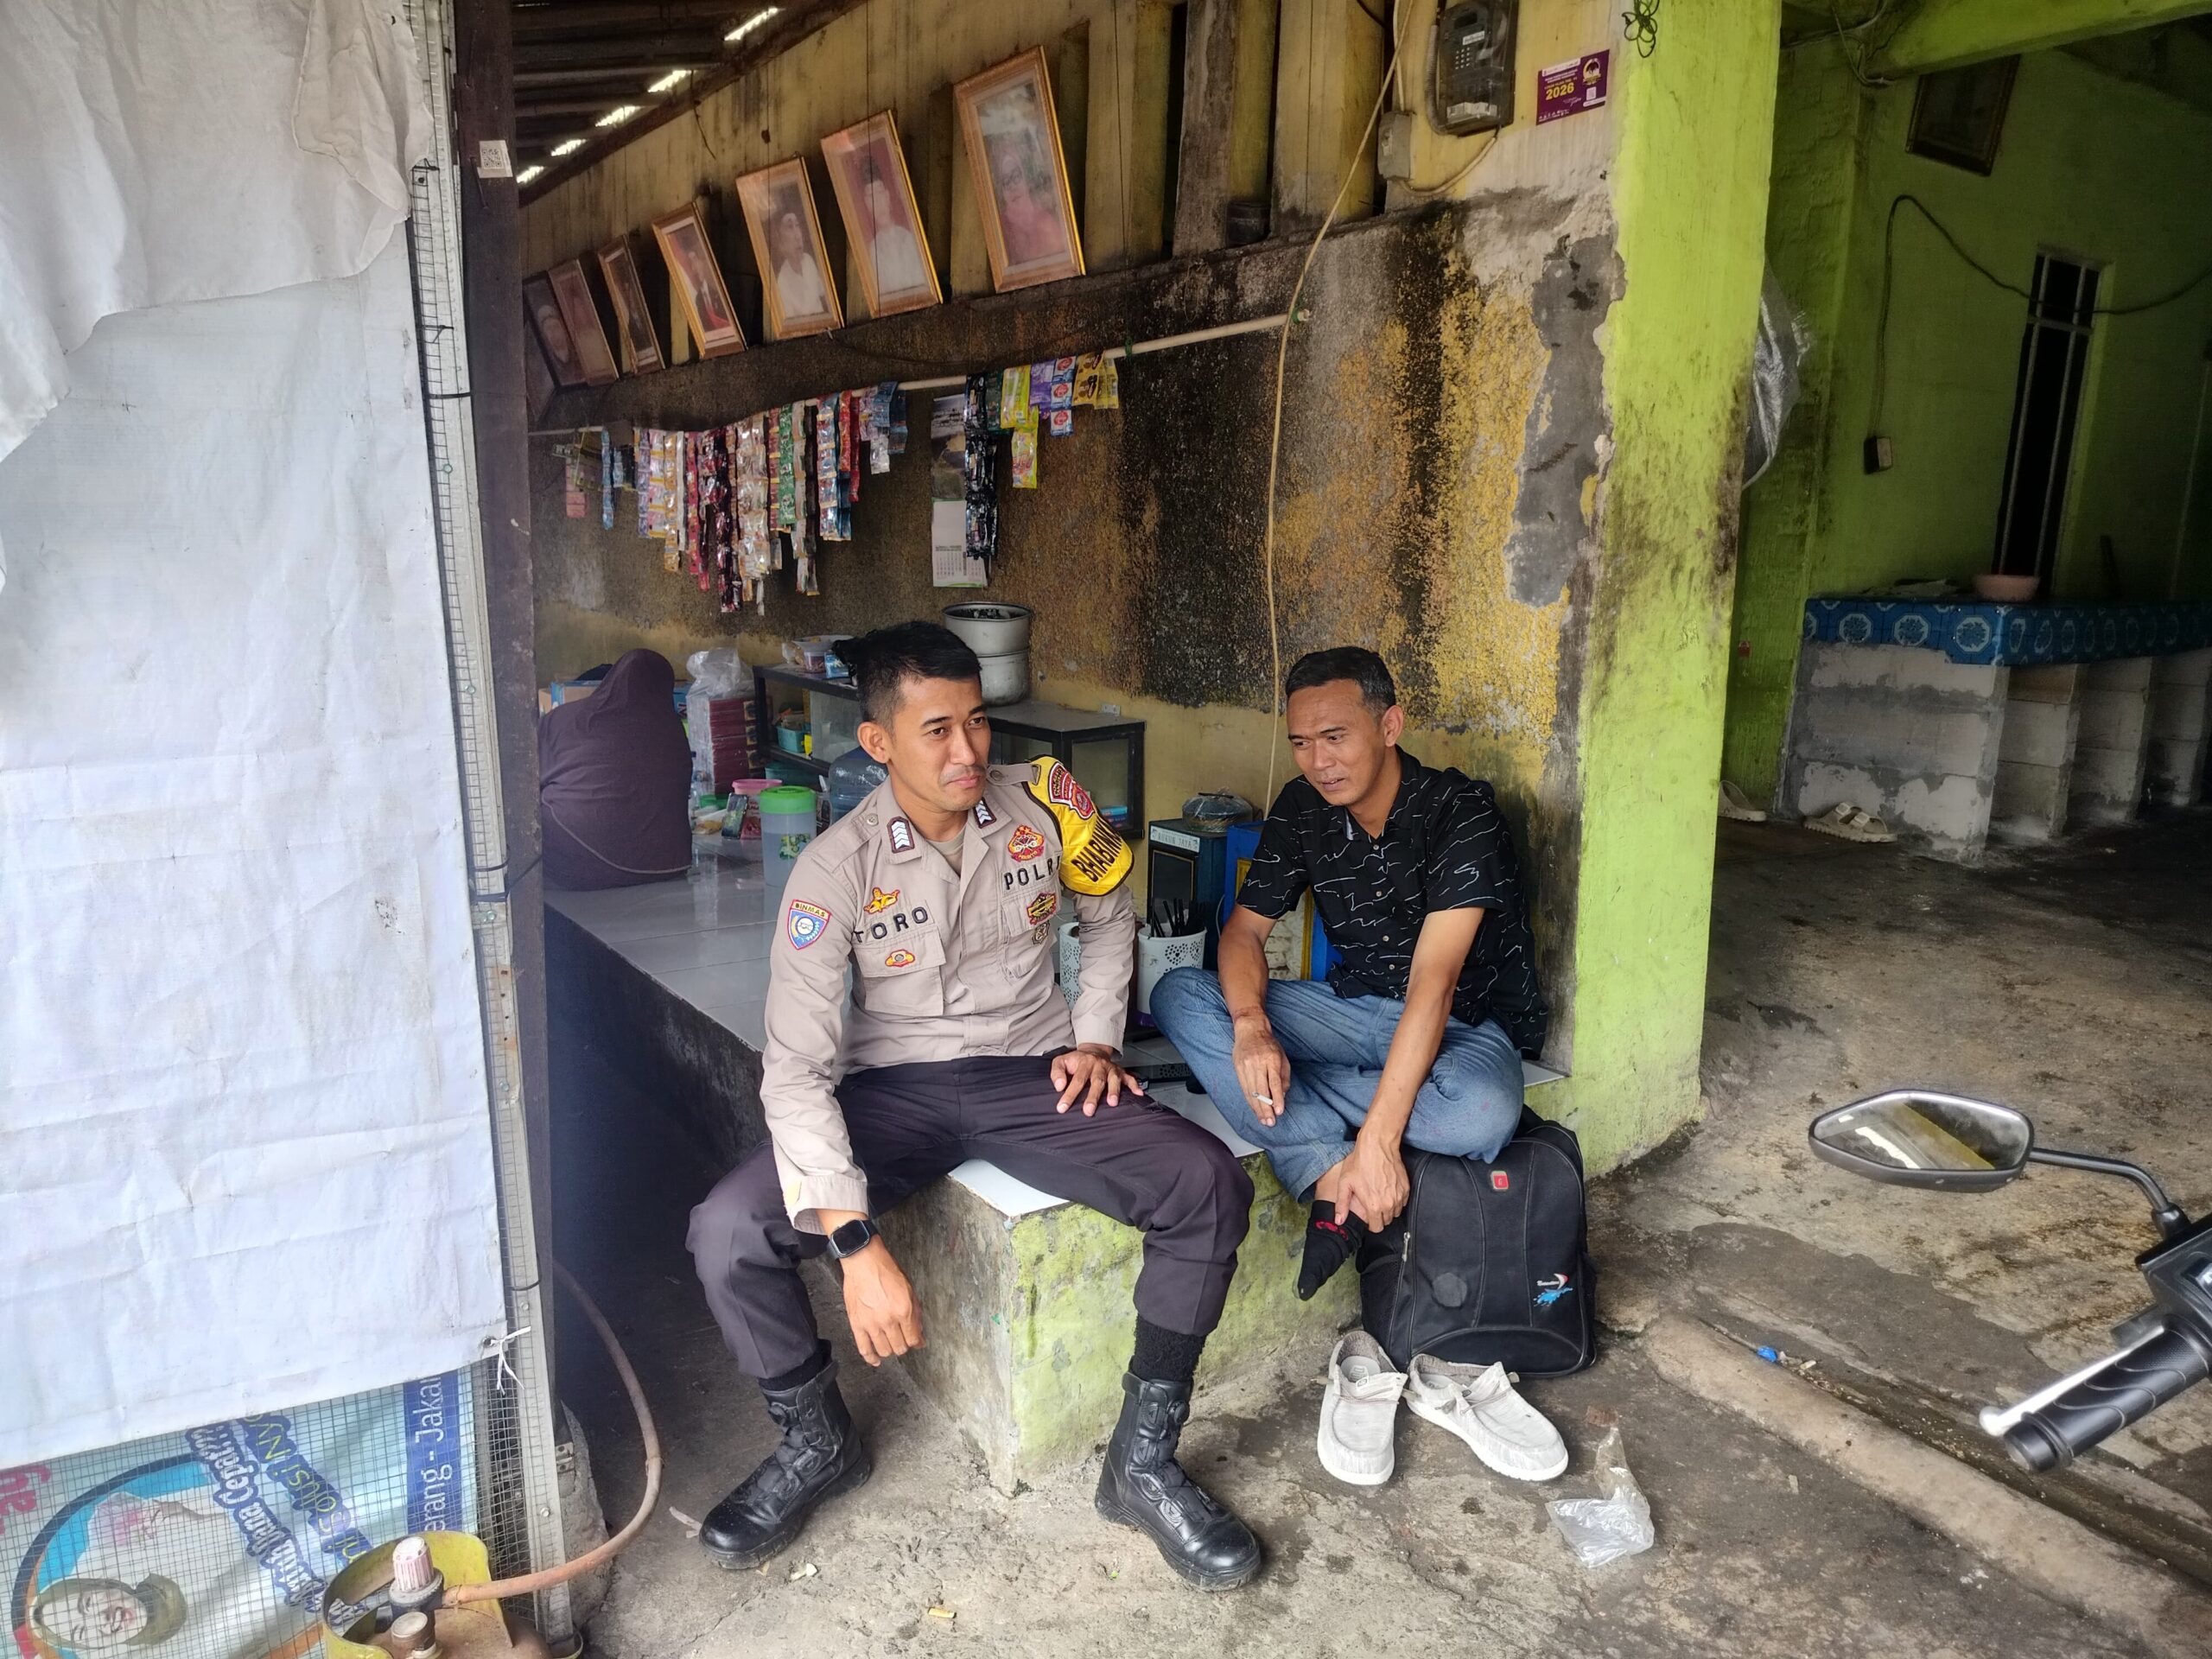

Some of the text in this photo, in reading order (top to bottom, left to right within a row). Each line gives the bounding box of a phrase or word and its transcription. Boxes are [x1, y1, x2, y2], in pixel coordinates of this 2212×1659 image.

[1546, 82, 1574, 100] 2026
[795, 902, 826, 918] BINMAS
[273, 1464, 343, 1533] Solusi
[238, 1502, 287, 1553] Dana
